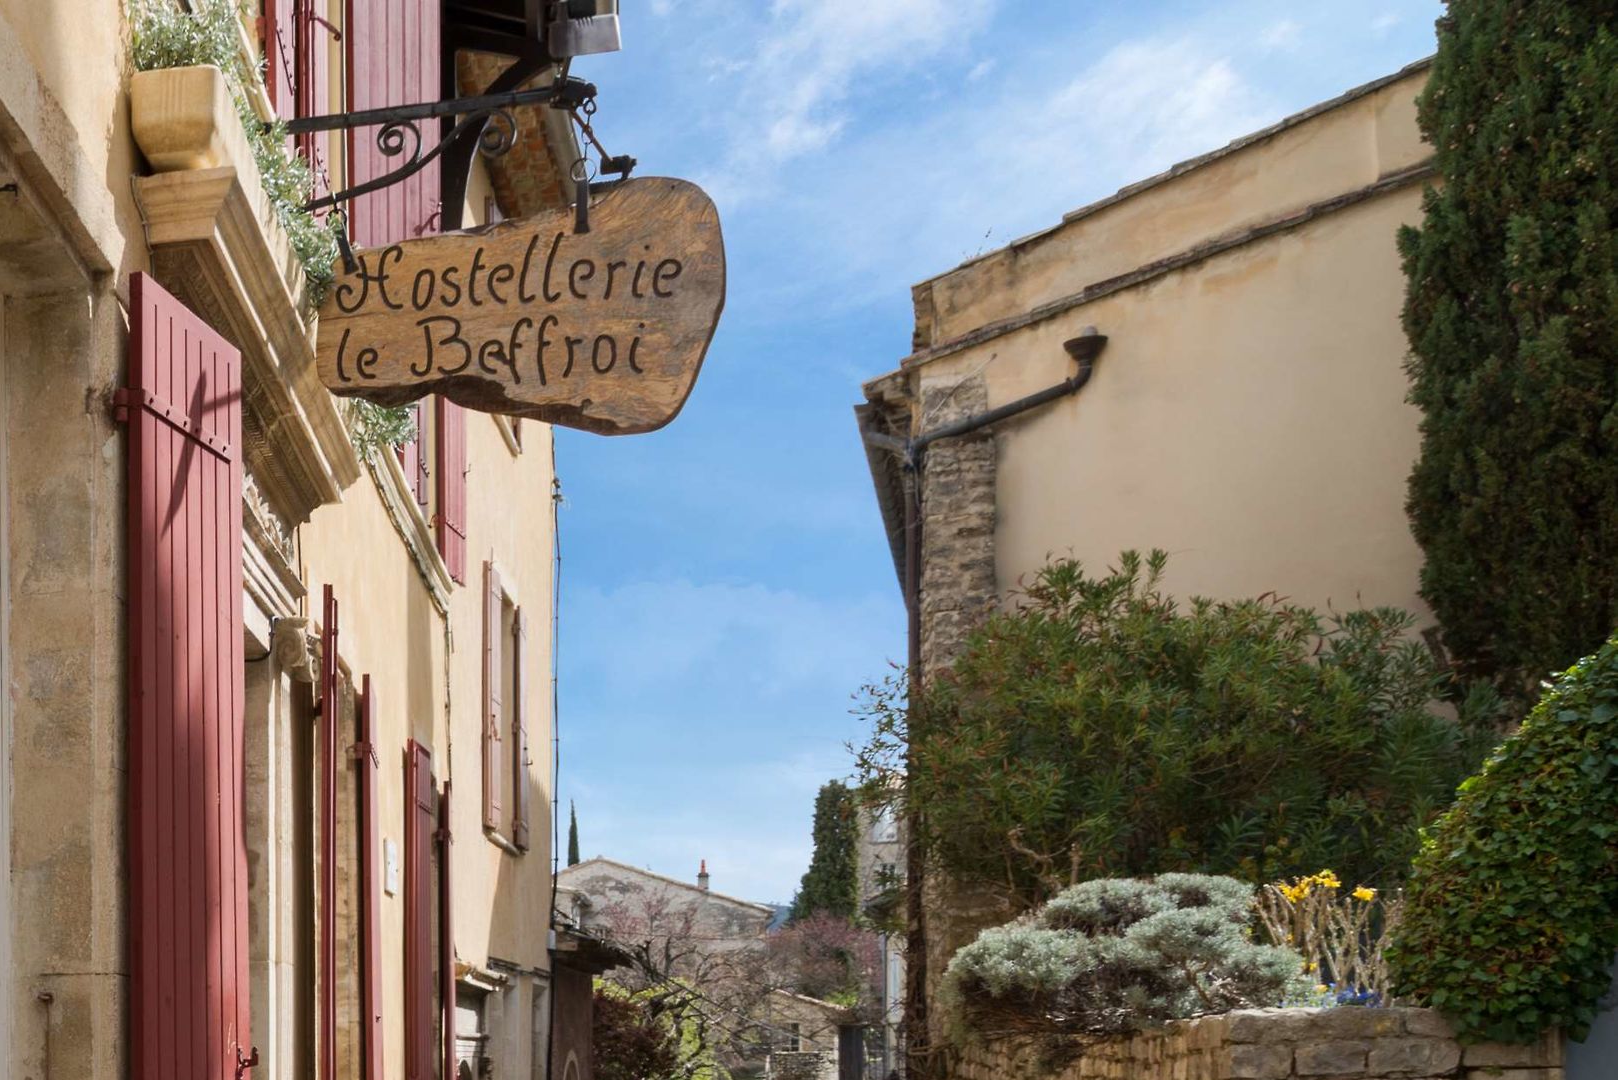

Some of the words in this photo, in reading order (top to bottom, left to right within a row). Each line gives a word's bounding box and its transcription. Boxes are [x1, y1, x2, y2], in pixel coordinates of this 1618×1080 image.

[336, 232, 682, 313] Hostellerie
[336, 328, 379, 382] le
[410, 314, 645, 386] Beffroi
